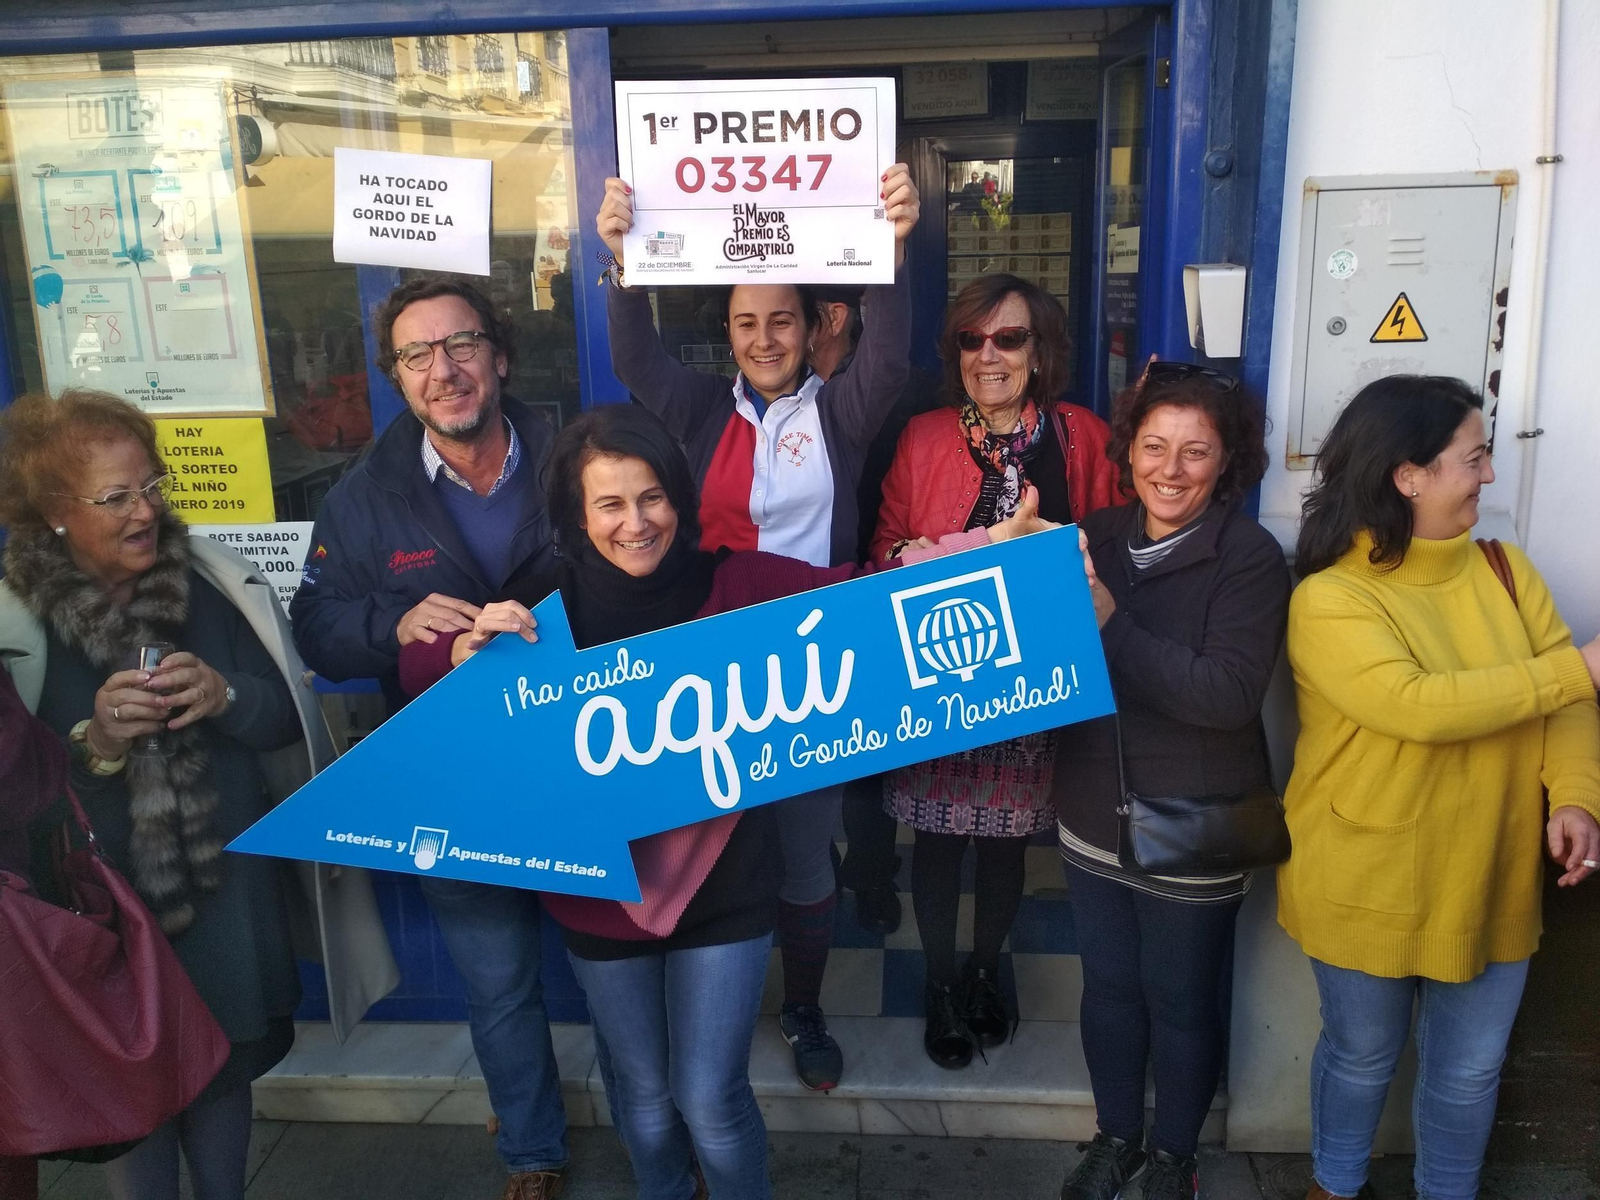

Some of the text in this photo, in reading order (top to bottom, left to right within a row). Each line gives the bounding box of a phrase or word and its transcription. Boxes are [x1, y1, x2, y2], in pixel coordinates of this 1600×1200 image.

[912, 101, 953, 110] VENDIDO
[77, 95, 155, 134] BOTES
[641, 107, 862, 145] 1er PREMIO
[675, 154, 833, 194] 03347
[359, 174, 448, 192] HA TOCADO
[372, 192, 434, 208] AQUI EL
[352, 208, 454, 227] GORDO DE LA
[732, 202, 786, 228] EL MAYOR
[369, 226, 437, 242] NAVIDAD
[732, 217, 774, 242] PREMIO
[66, 249, 88, 257] MILLONES
[94, 248, 109, 256] EUROS
[723, 237, 795, 262] COMPARTIRLO
[66, 307, 78, 315] ESTE
[155, 304, 168, 312] ESTE
[111, 355, 126, 363] EUROS
[175, 428, 203, 437] HAY
[796, 431, 813, 444] TIME
[164, 446, 224, 456] LOTERIA
[165, 464, 238, 474] EL SORTEO
[172, 479, 227, 492] EL NIÑO
[169, 499, 245, 510] NERO 2019
[247, 532, 300, 542] SABADO
[233, 546, 289, 555] IMITIVA
[252, 561, 295, 573] .000
[573, 647, 655, 695] caido
[574, 608, 855, 810] aquí
[749, 663, 1081, 782] el Gordo de Navidad!
[325, 829, 607, 878] Loterías y Apuestas del Estado
